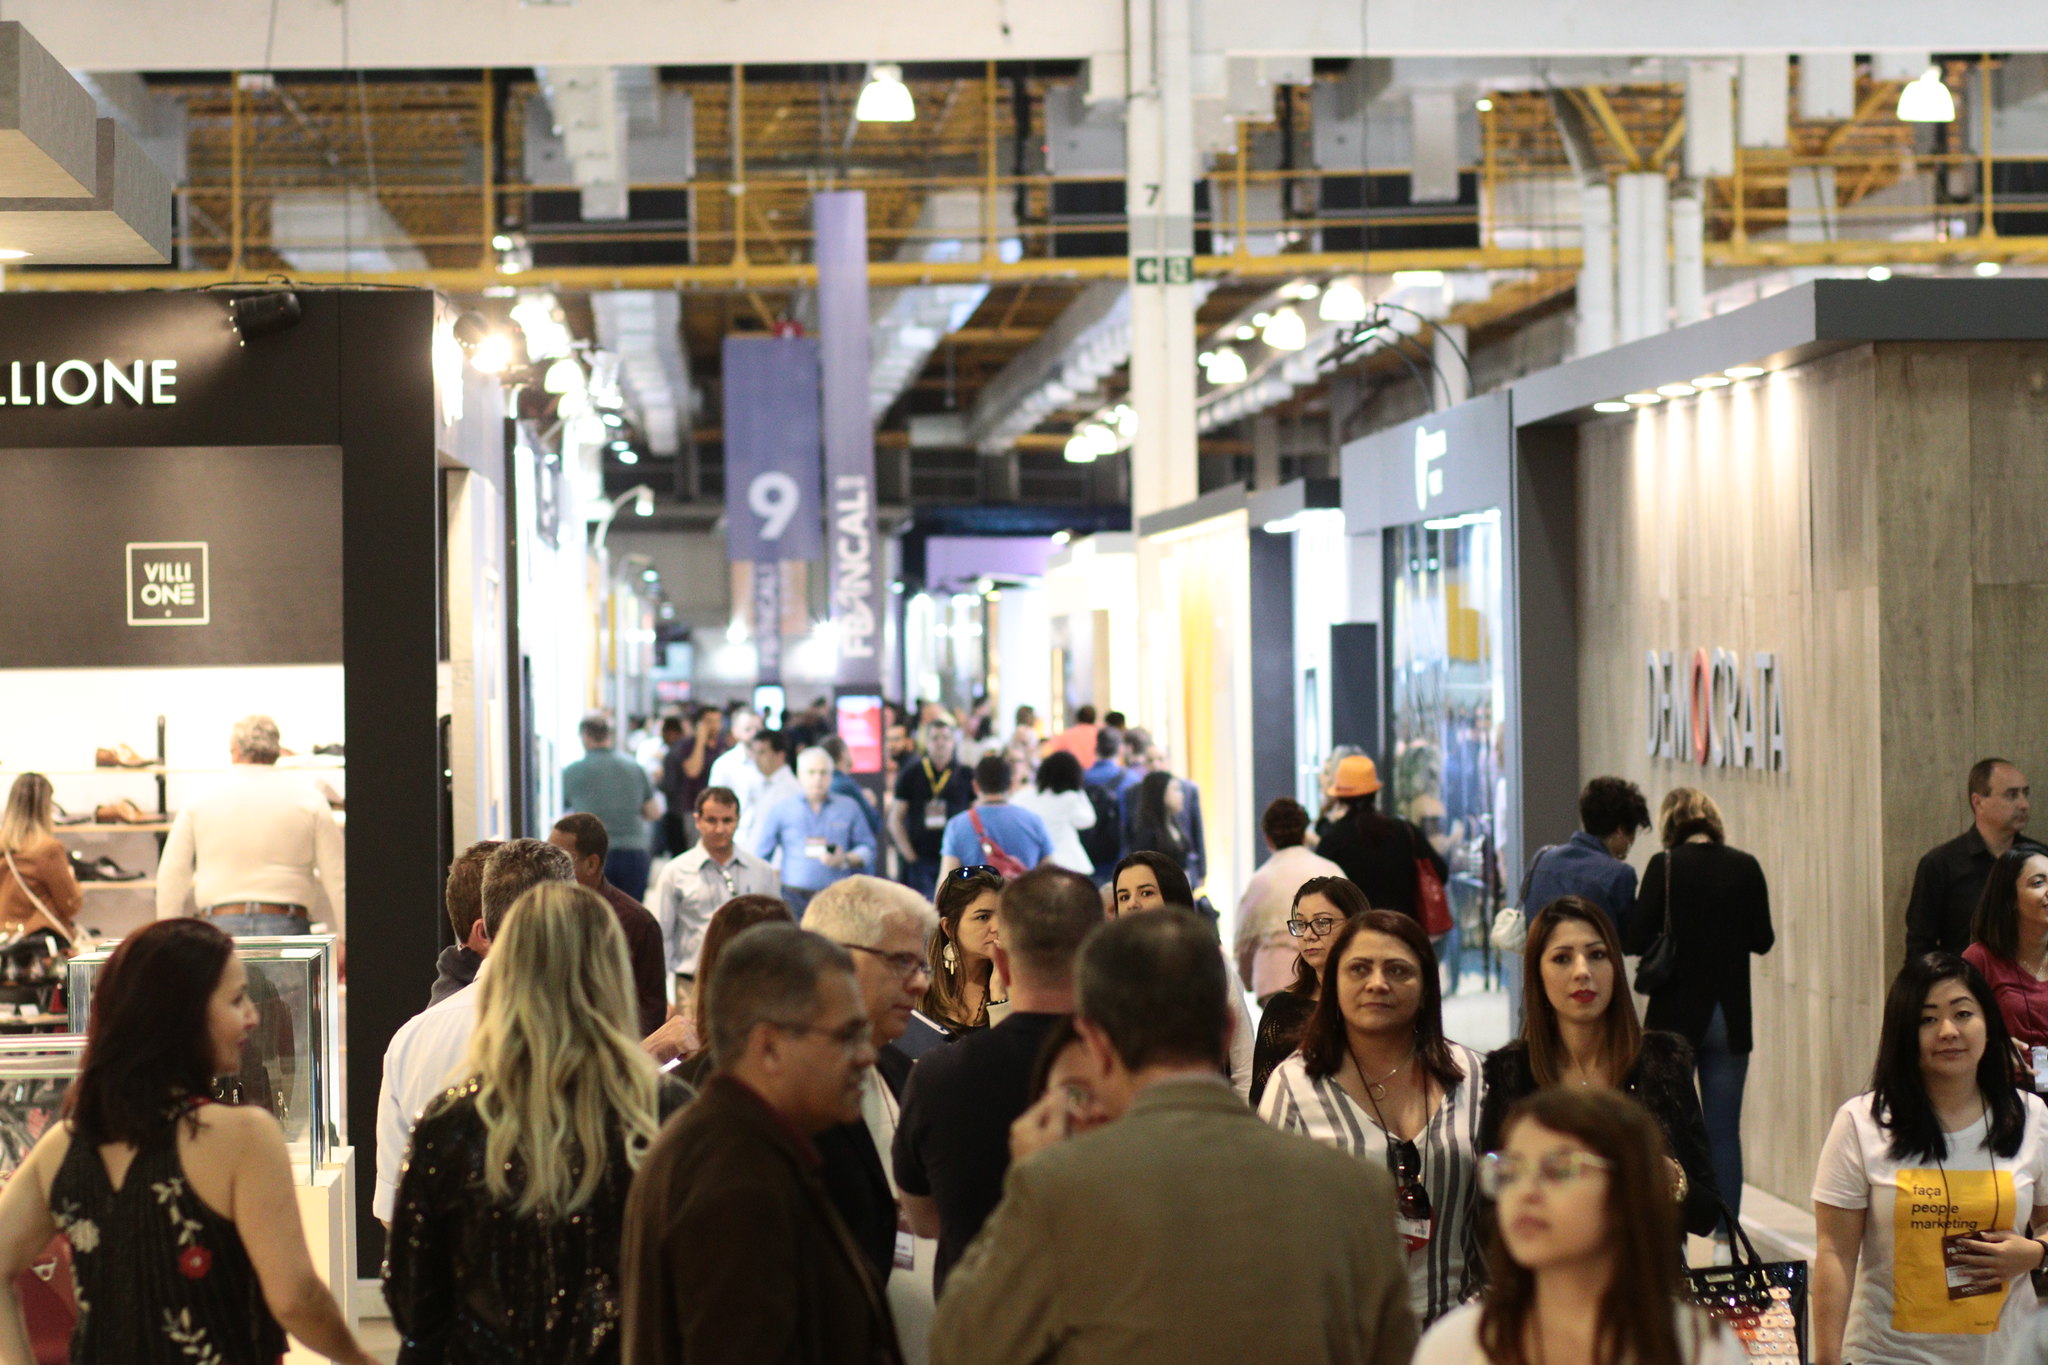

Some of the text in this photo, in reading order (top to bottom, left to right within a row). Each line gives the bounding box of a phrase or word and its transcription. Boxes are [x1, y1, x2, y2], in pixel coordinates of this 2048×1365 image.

[1144, 184, 1160, 206] 7
[0, 359, 177, 405] LIONE
[748, 471, 799, 540] 9
[144, 562, 191, 582] VILLI
[141, 583, 195, 605] ONE
[1645, 647, 1787, 772] DEMOCRATA
[1913, 1184, 1942, 1199] faça
[1912, 1202, 1959, 1215] peope
[1911, 1217, 1978, 1231] marketing
